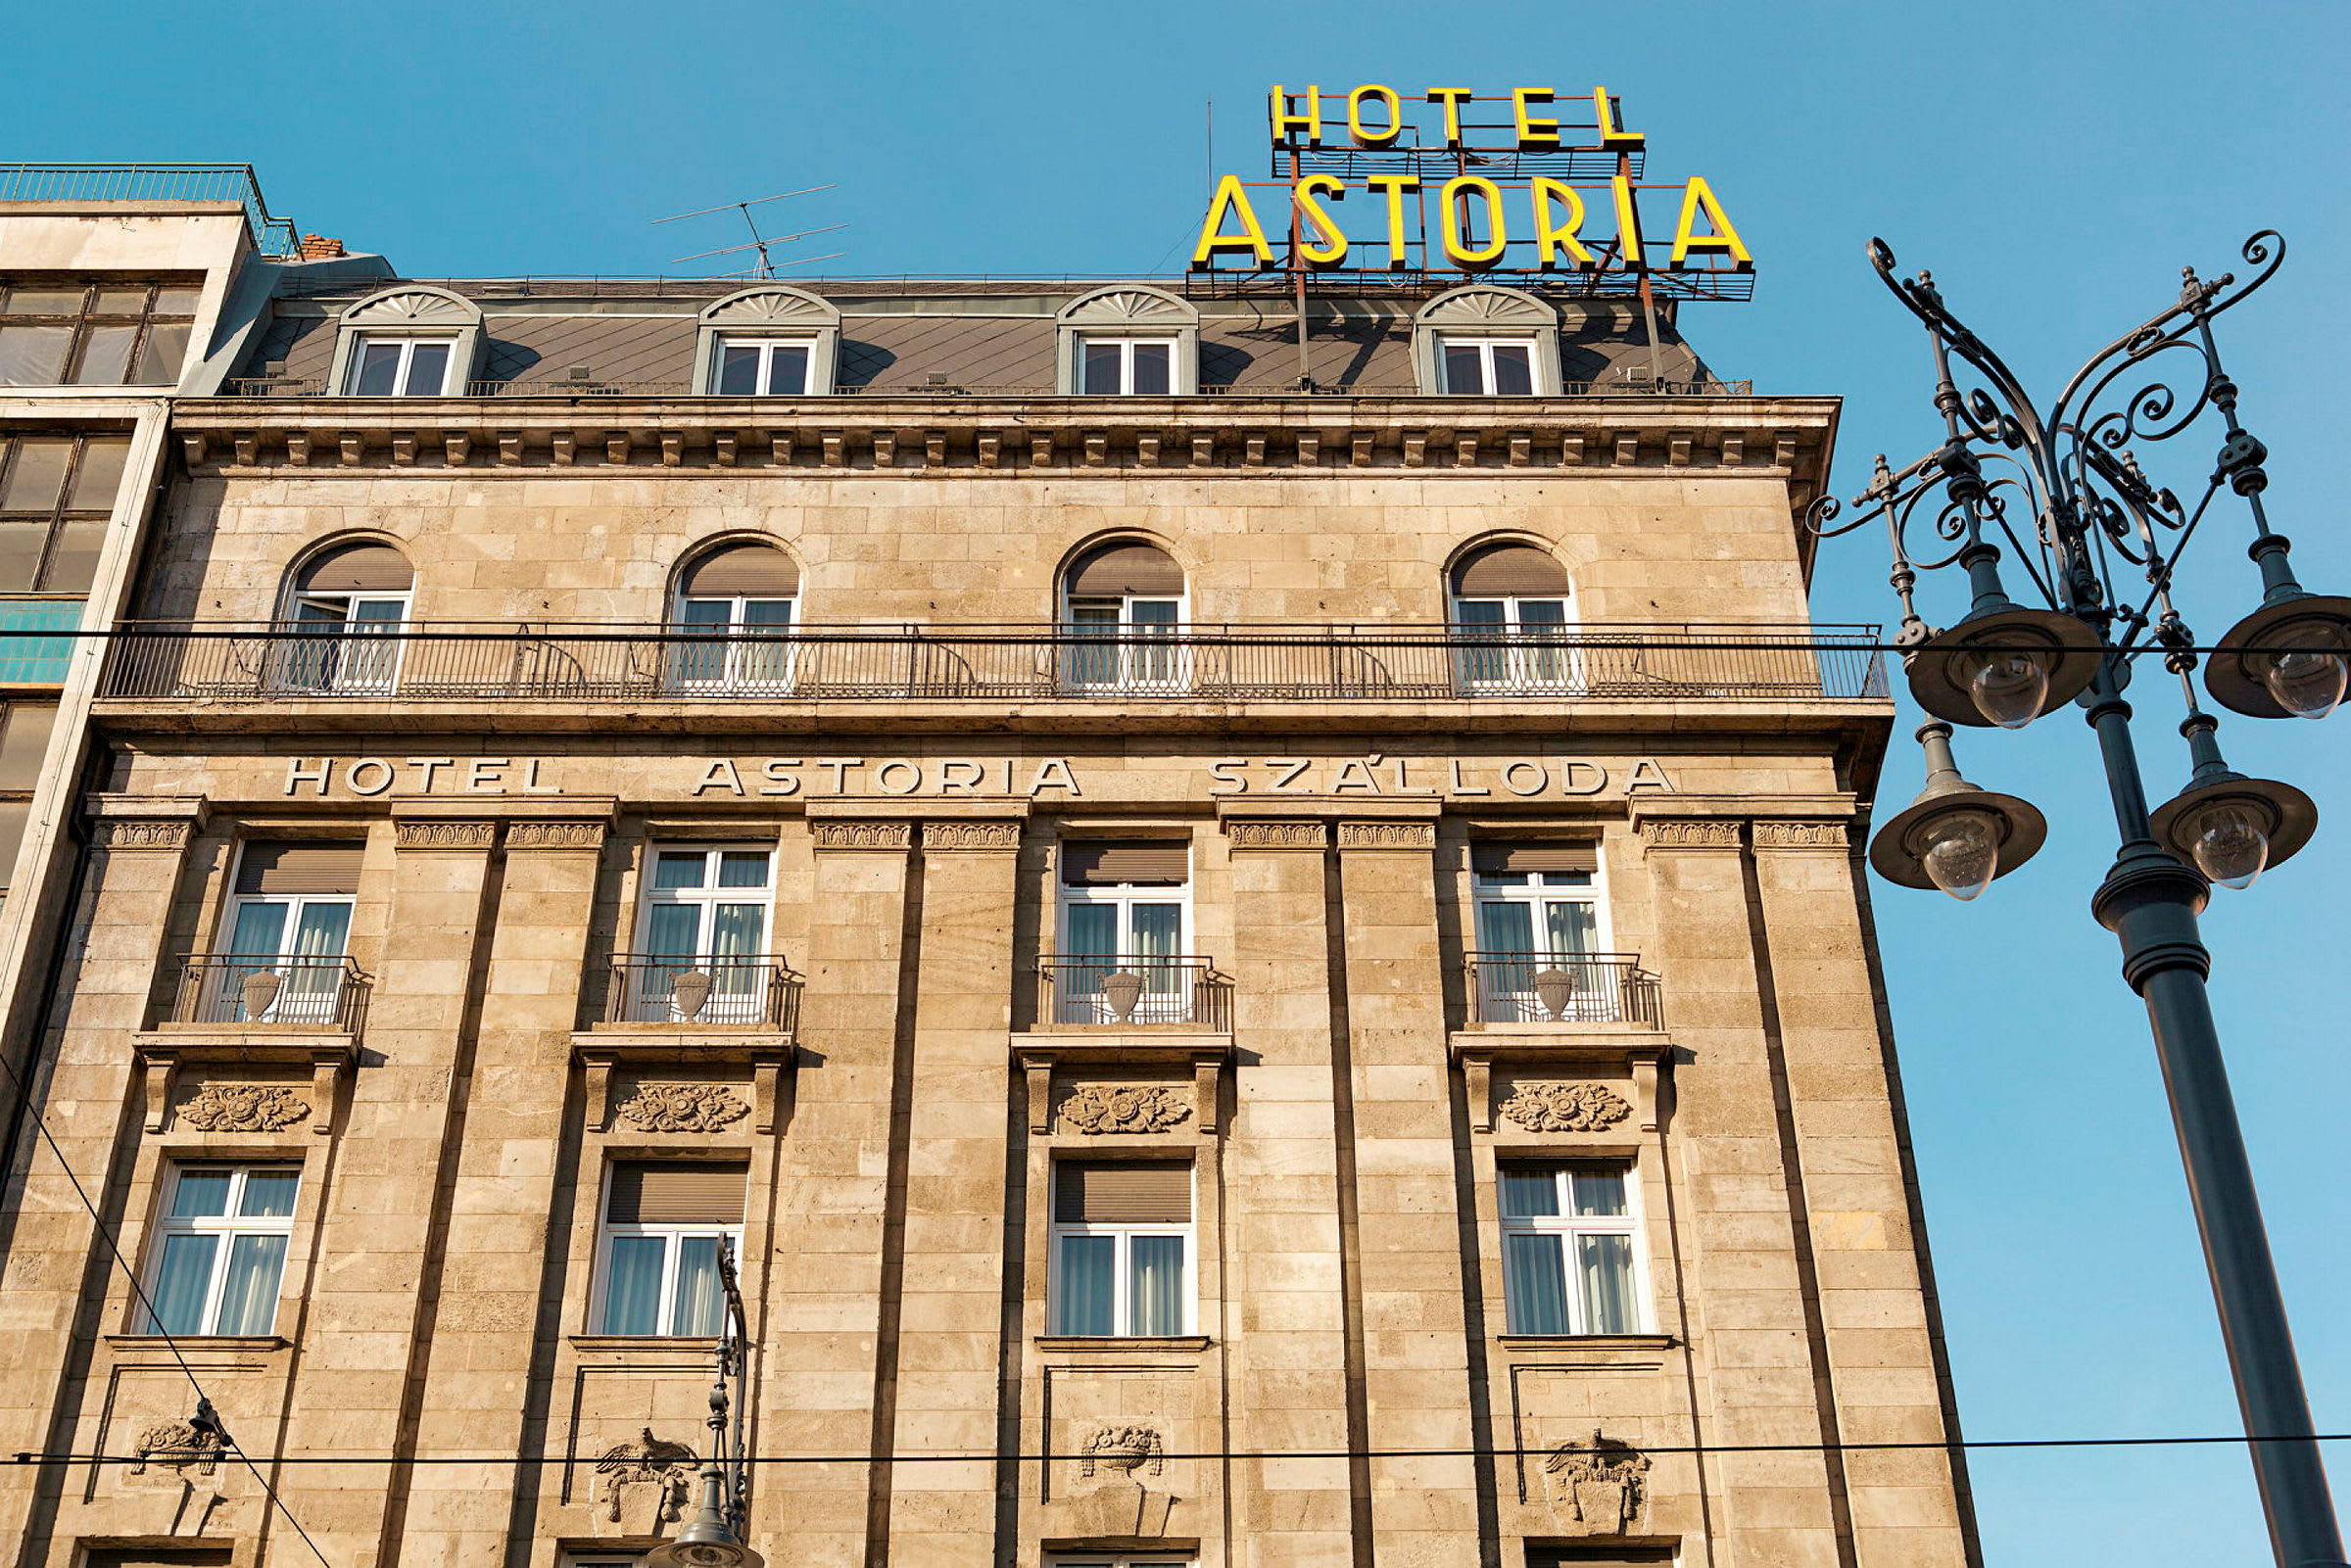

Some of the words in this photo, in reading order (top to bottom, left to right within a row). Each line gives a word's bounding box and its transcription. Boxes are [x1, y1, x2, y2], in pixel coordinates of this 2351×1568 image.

[1271, 84, 1645, 149] HOTEL
[1191, 174, 1753, 270] ASTORIA
[283, 756, 563, 795] HOTEL
[692, 756, 1081, 796] ASTORIA
[1208, 753, 1675, 795] SZÁLLODA
